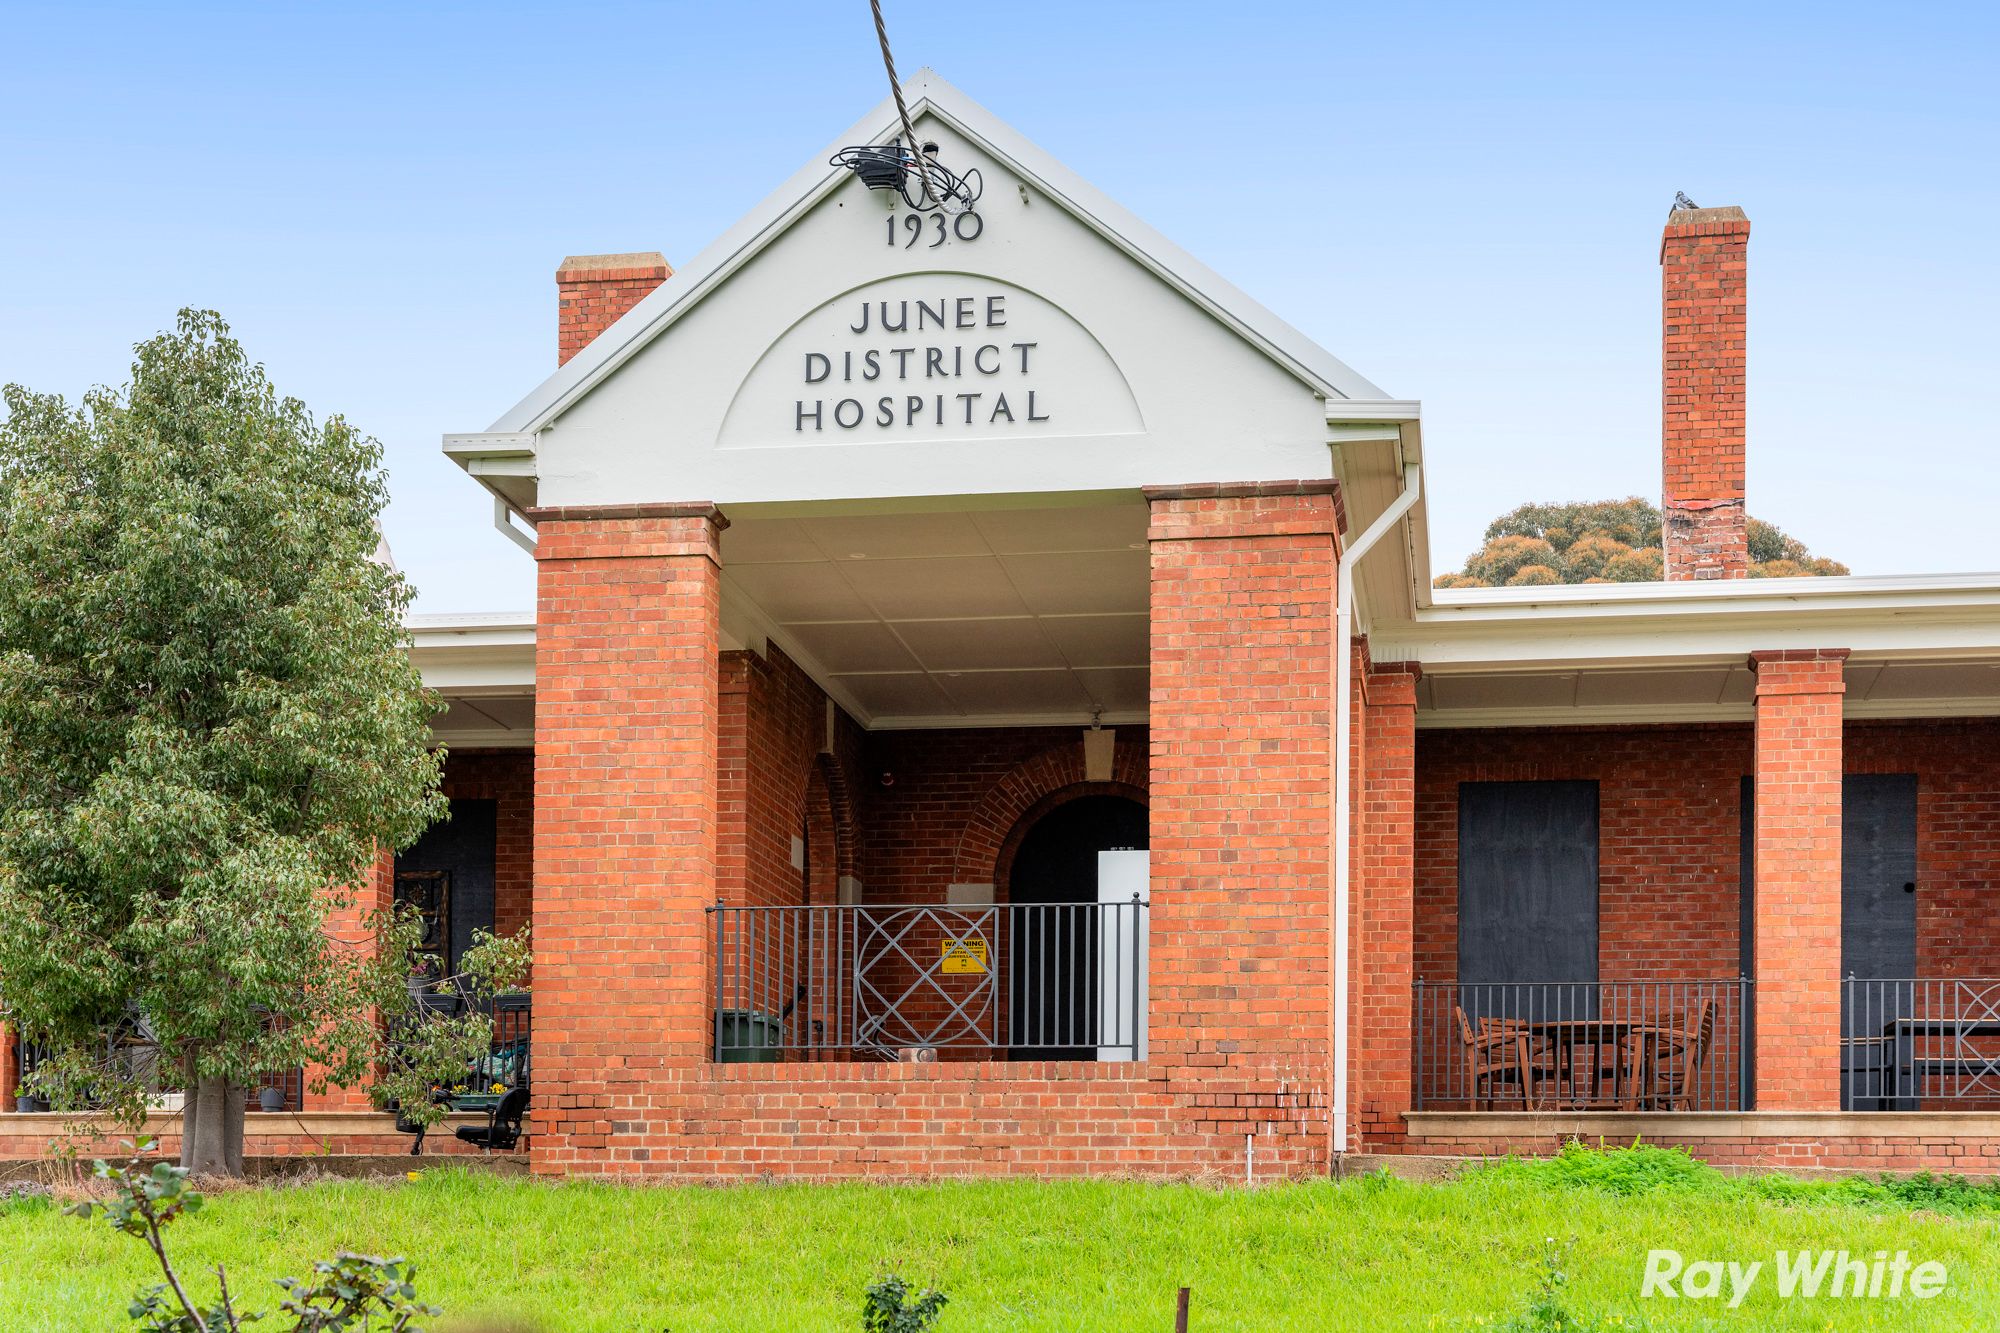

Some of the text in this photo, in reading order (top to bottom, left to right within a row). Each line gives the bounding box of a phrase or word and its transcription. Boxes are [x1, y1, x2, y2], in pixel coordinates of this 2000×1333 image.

[886, 210, 984, 250] 1930
[850, 296, 1007, 334] JUNEE
[804, 342, 1038, 383] DISTRICT
[795, 390, 1050, 431] HOSPITAL
